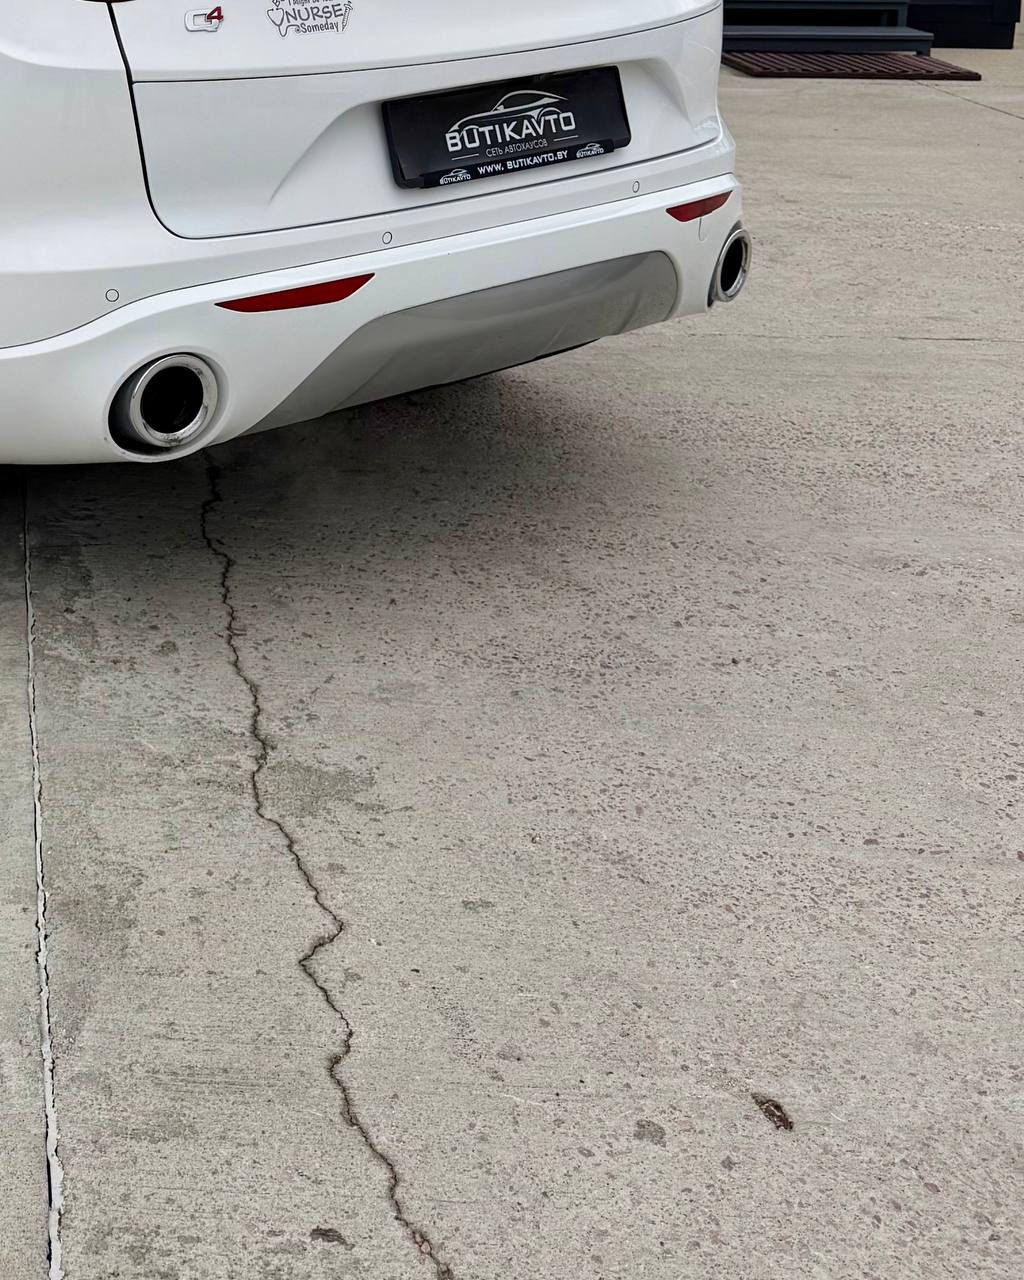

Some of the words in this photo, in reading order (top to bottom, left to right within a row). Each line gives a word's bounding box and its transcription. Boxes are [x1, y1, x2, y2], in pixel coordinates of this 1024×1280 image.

[285, 3, 343, 24] NURSE
[300, 19, 339, 34] Someday
[445, 112, 576, 151] BUTIKAVTO
[485, 145, 504, 158] СЕТЬ
[504, 138, 549, 154] АВТОХАУСОВ
[439, 173, 472, 185] BUTIKAVTO
[506, 150, 569, 170] BUTIKAVTO.BY
